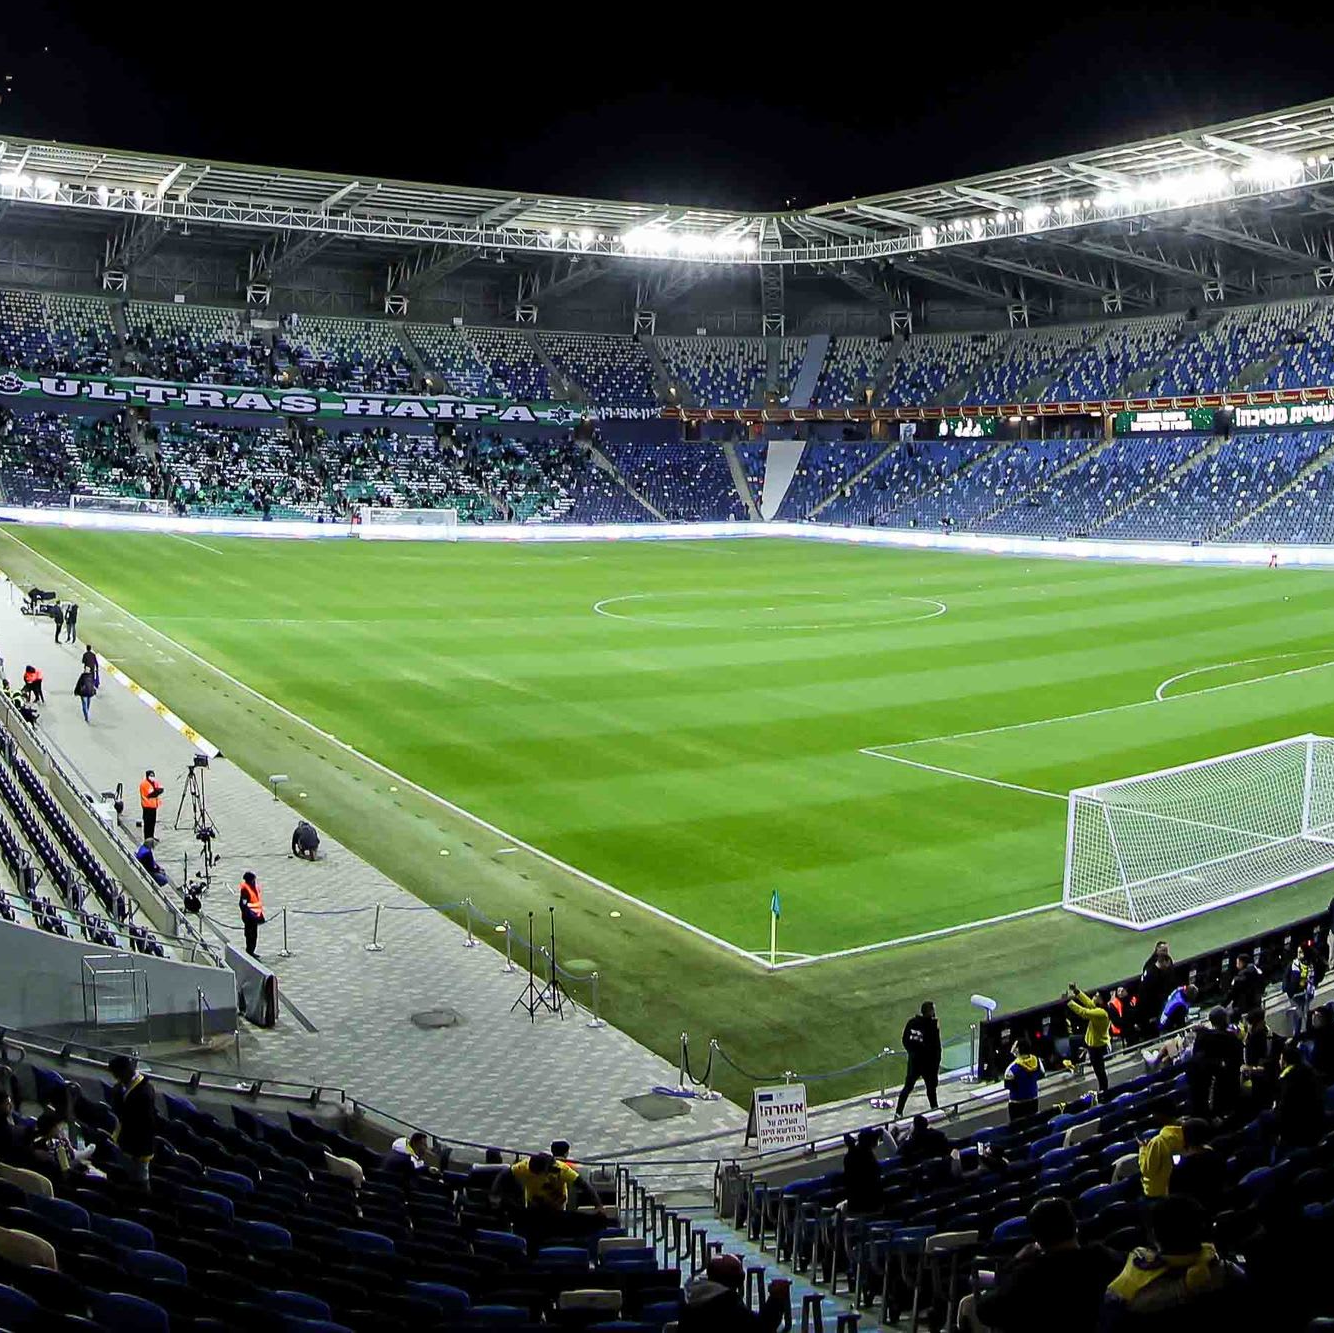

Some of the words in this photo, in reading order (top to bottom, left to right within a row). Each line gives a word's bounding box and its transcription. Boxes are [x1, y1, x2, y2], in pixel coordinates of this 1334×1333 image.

[39, 376, 317, 414] ULTRAS
[343, 398, 536, 422] HAIFA
[760, 1102, 803, 1116] אזהרה!
